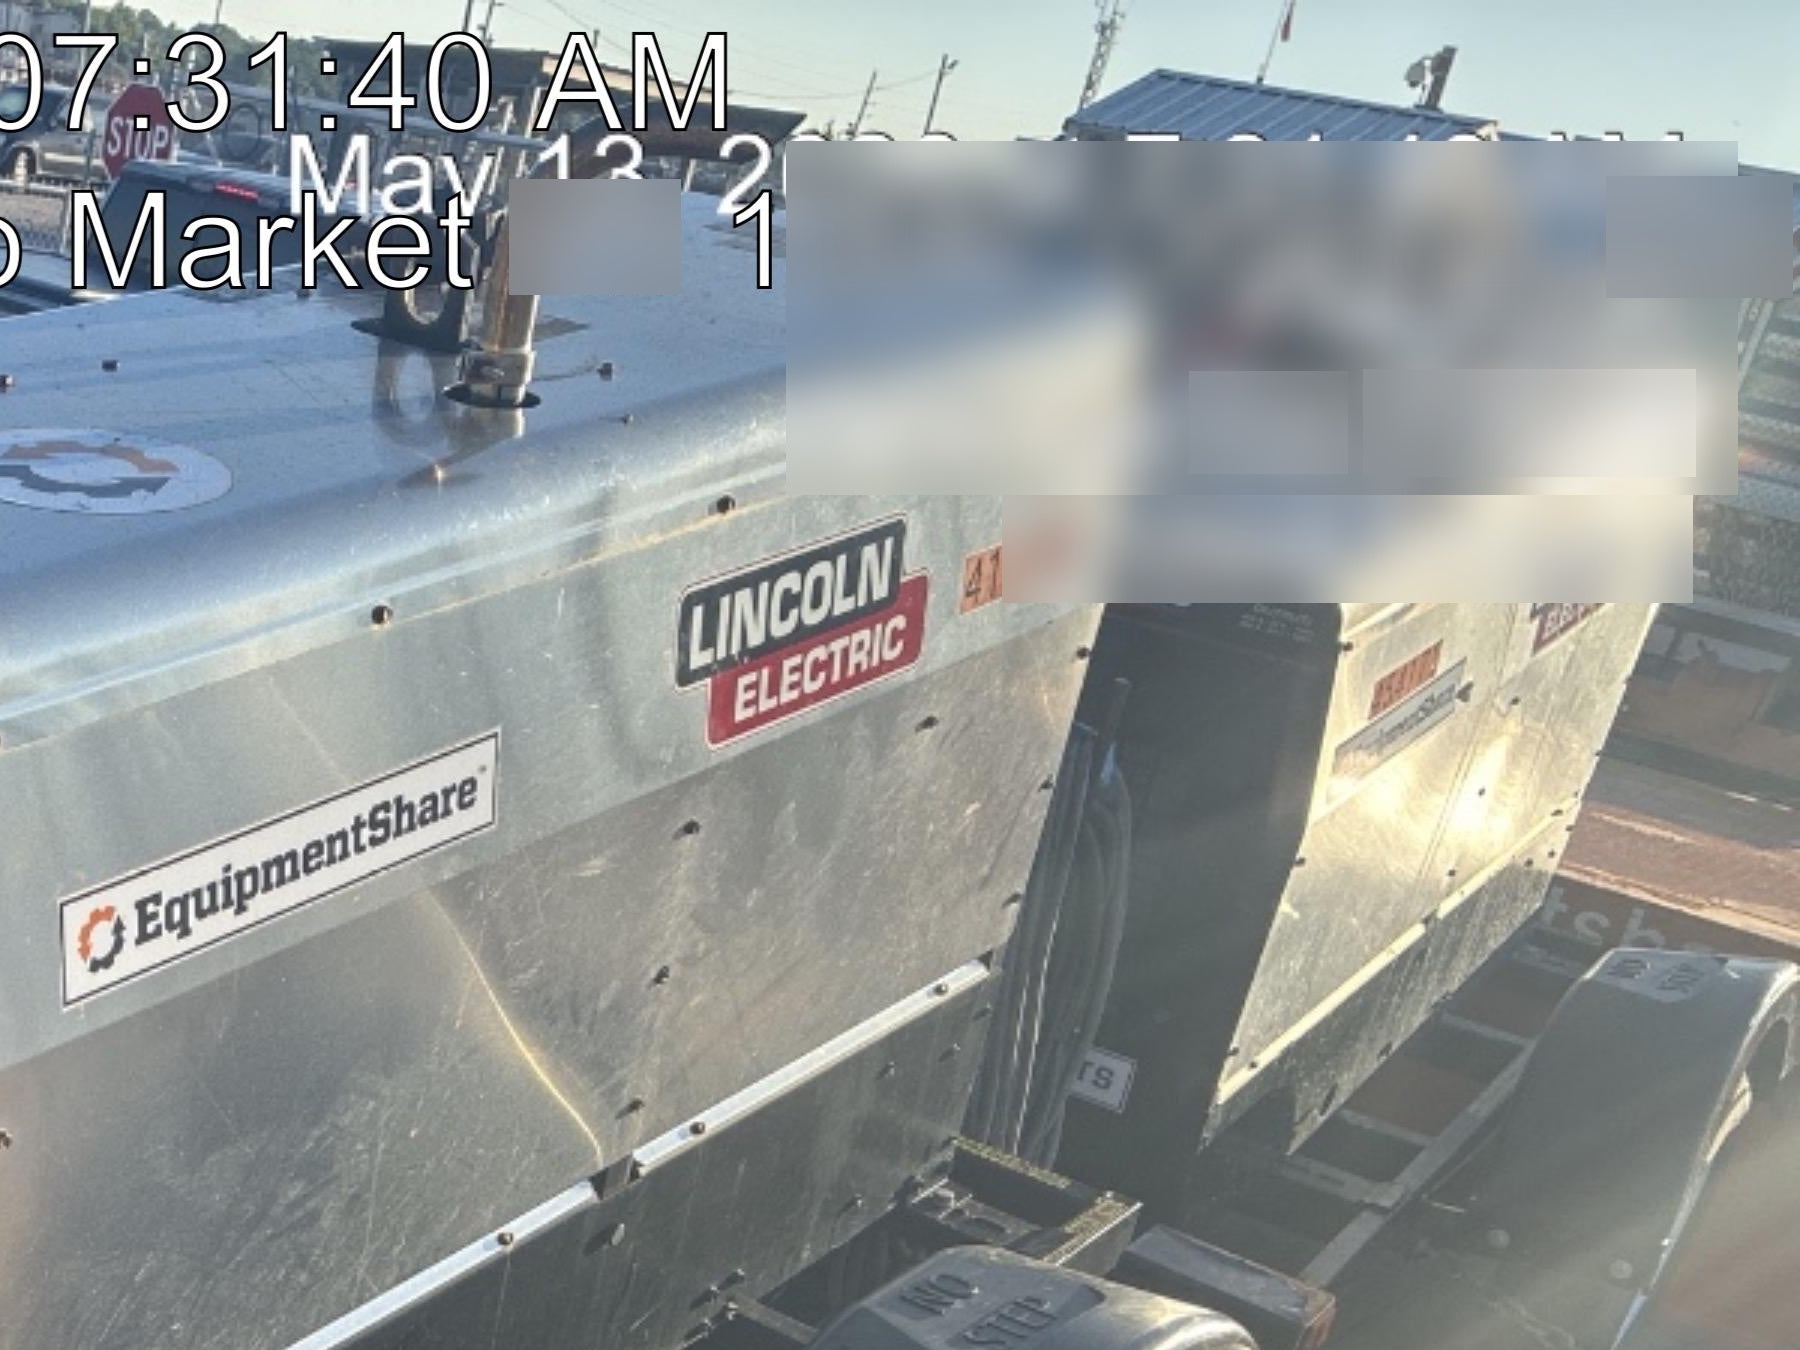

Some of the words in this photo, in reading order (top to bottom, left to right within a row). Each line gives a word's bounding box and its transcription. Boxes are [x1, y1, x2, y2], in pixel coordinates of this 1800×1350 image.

[107, 116, 169, 161] STOP
[688, 536, 895, 671] LINCOLN
[733, 614, 907, 724] ELECTRIC
[133, 774, 479, 948] EquipmentShare
[899, 1273, 973, 1318] NO
